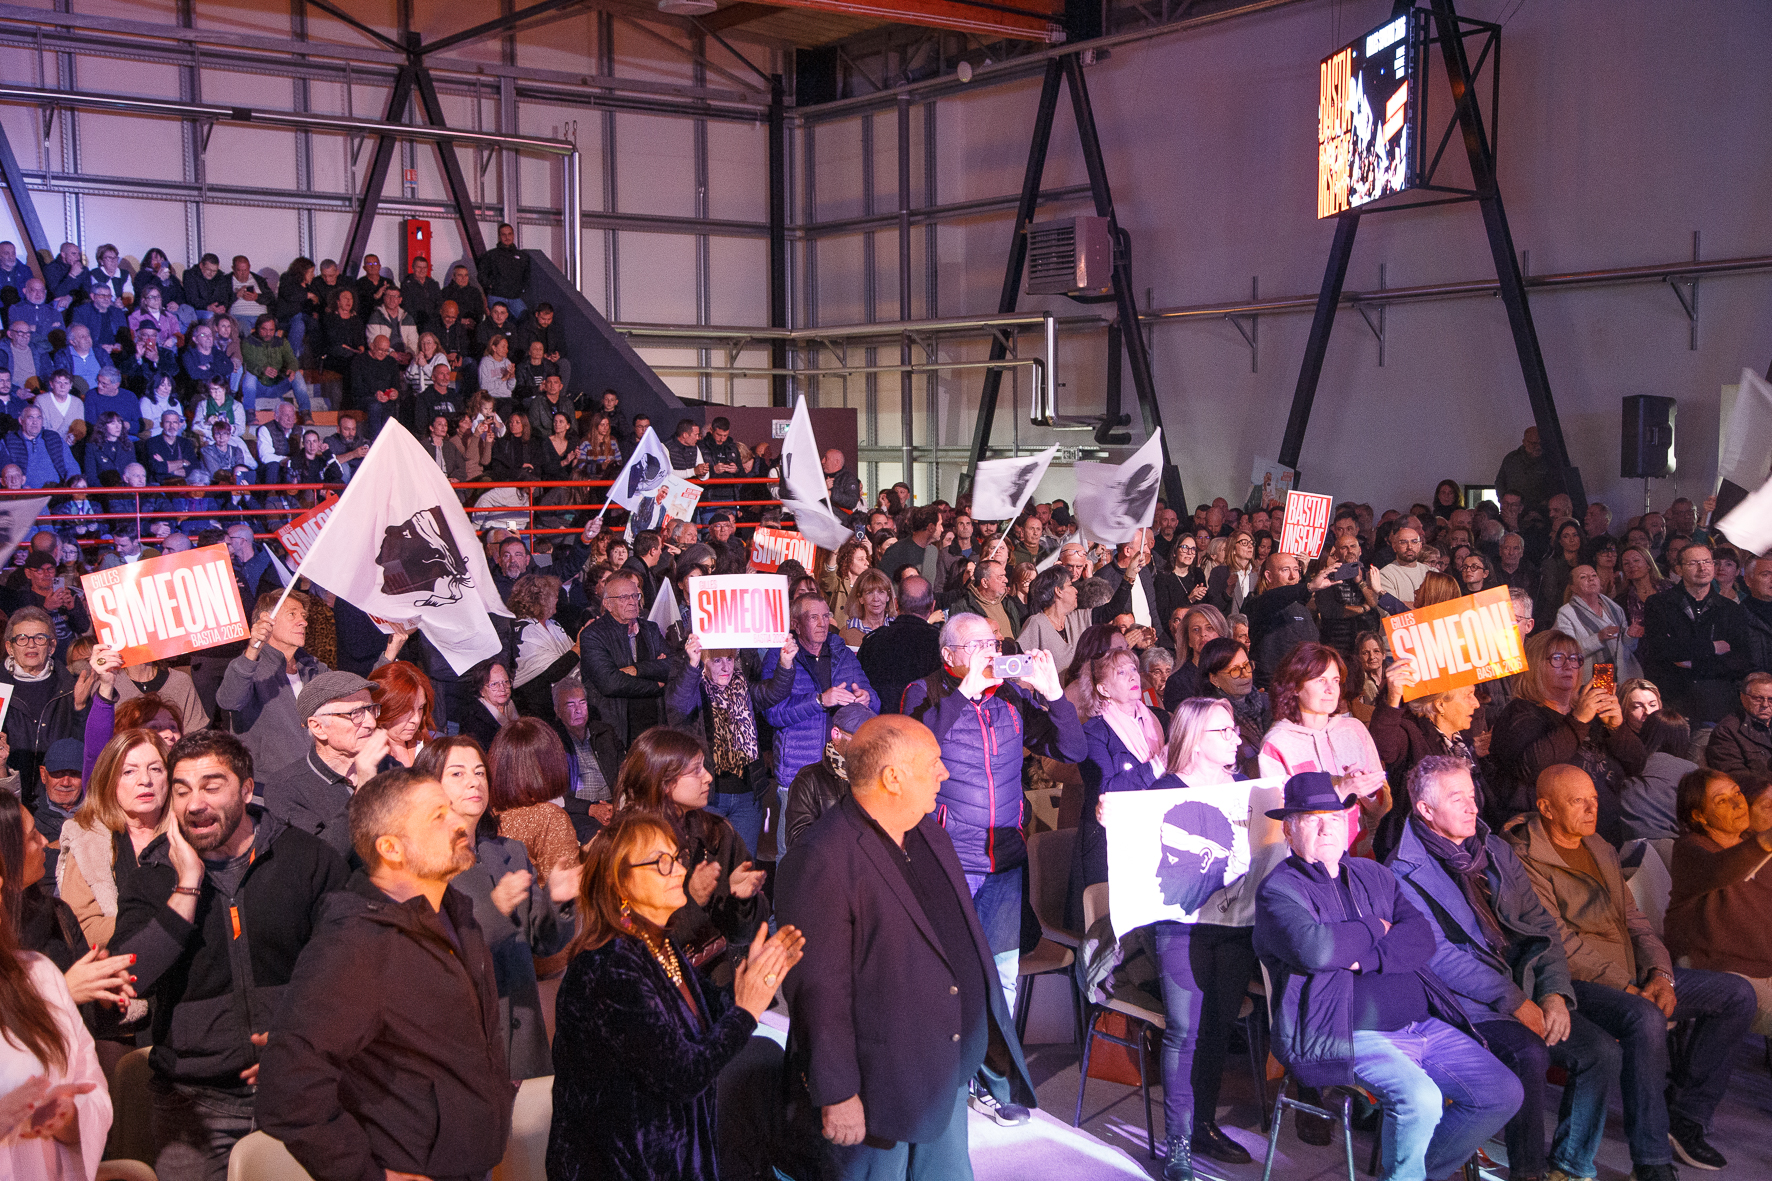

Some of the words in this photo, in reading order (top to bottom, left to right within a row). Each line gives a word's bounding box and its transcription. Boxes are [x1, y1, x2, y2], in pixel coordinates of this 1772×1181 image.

[1319, 47, 1351, 144] BASTIA
[1288, 494, 1327, 528] BASTIA
[753, 533, 815, 569] SIMEONI
[1282, 523, 1324, 556] INSEME
[91, 570, 120, 589] GILLES
[699, 580, 718, 590] GILLES
[92, 559, 241, 652] SIMEONI
[697, 588, 785, 634] SIMEONI
[1390, 612, 1416, 630] GILLES
[191, 630, 222, 648] BASTIA
[222, 623, 244, 641] 2026
[753, 634, 771, 643] BASTIA
[1391, 600, 1520, 684] SIMEONI
[1476, 663, 1503, 680] BASTIA
[1504, 657, 1523, 673] 2026
